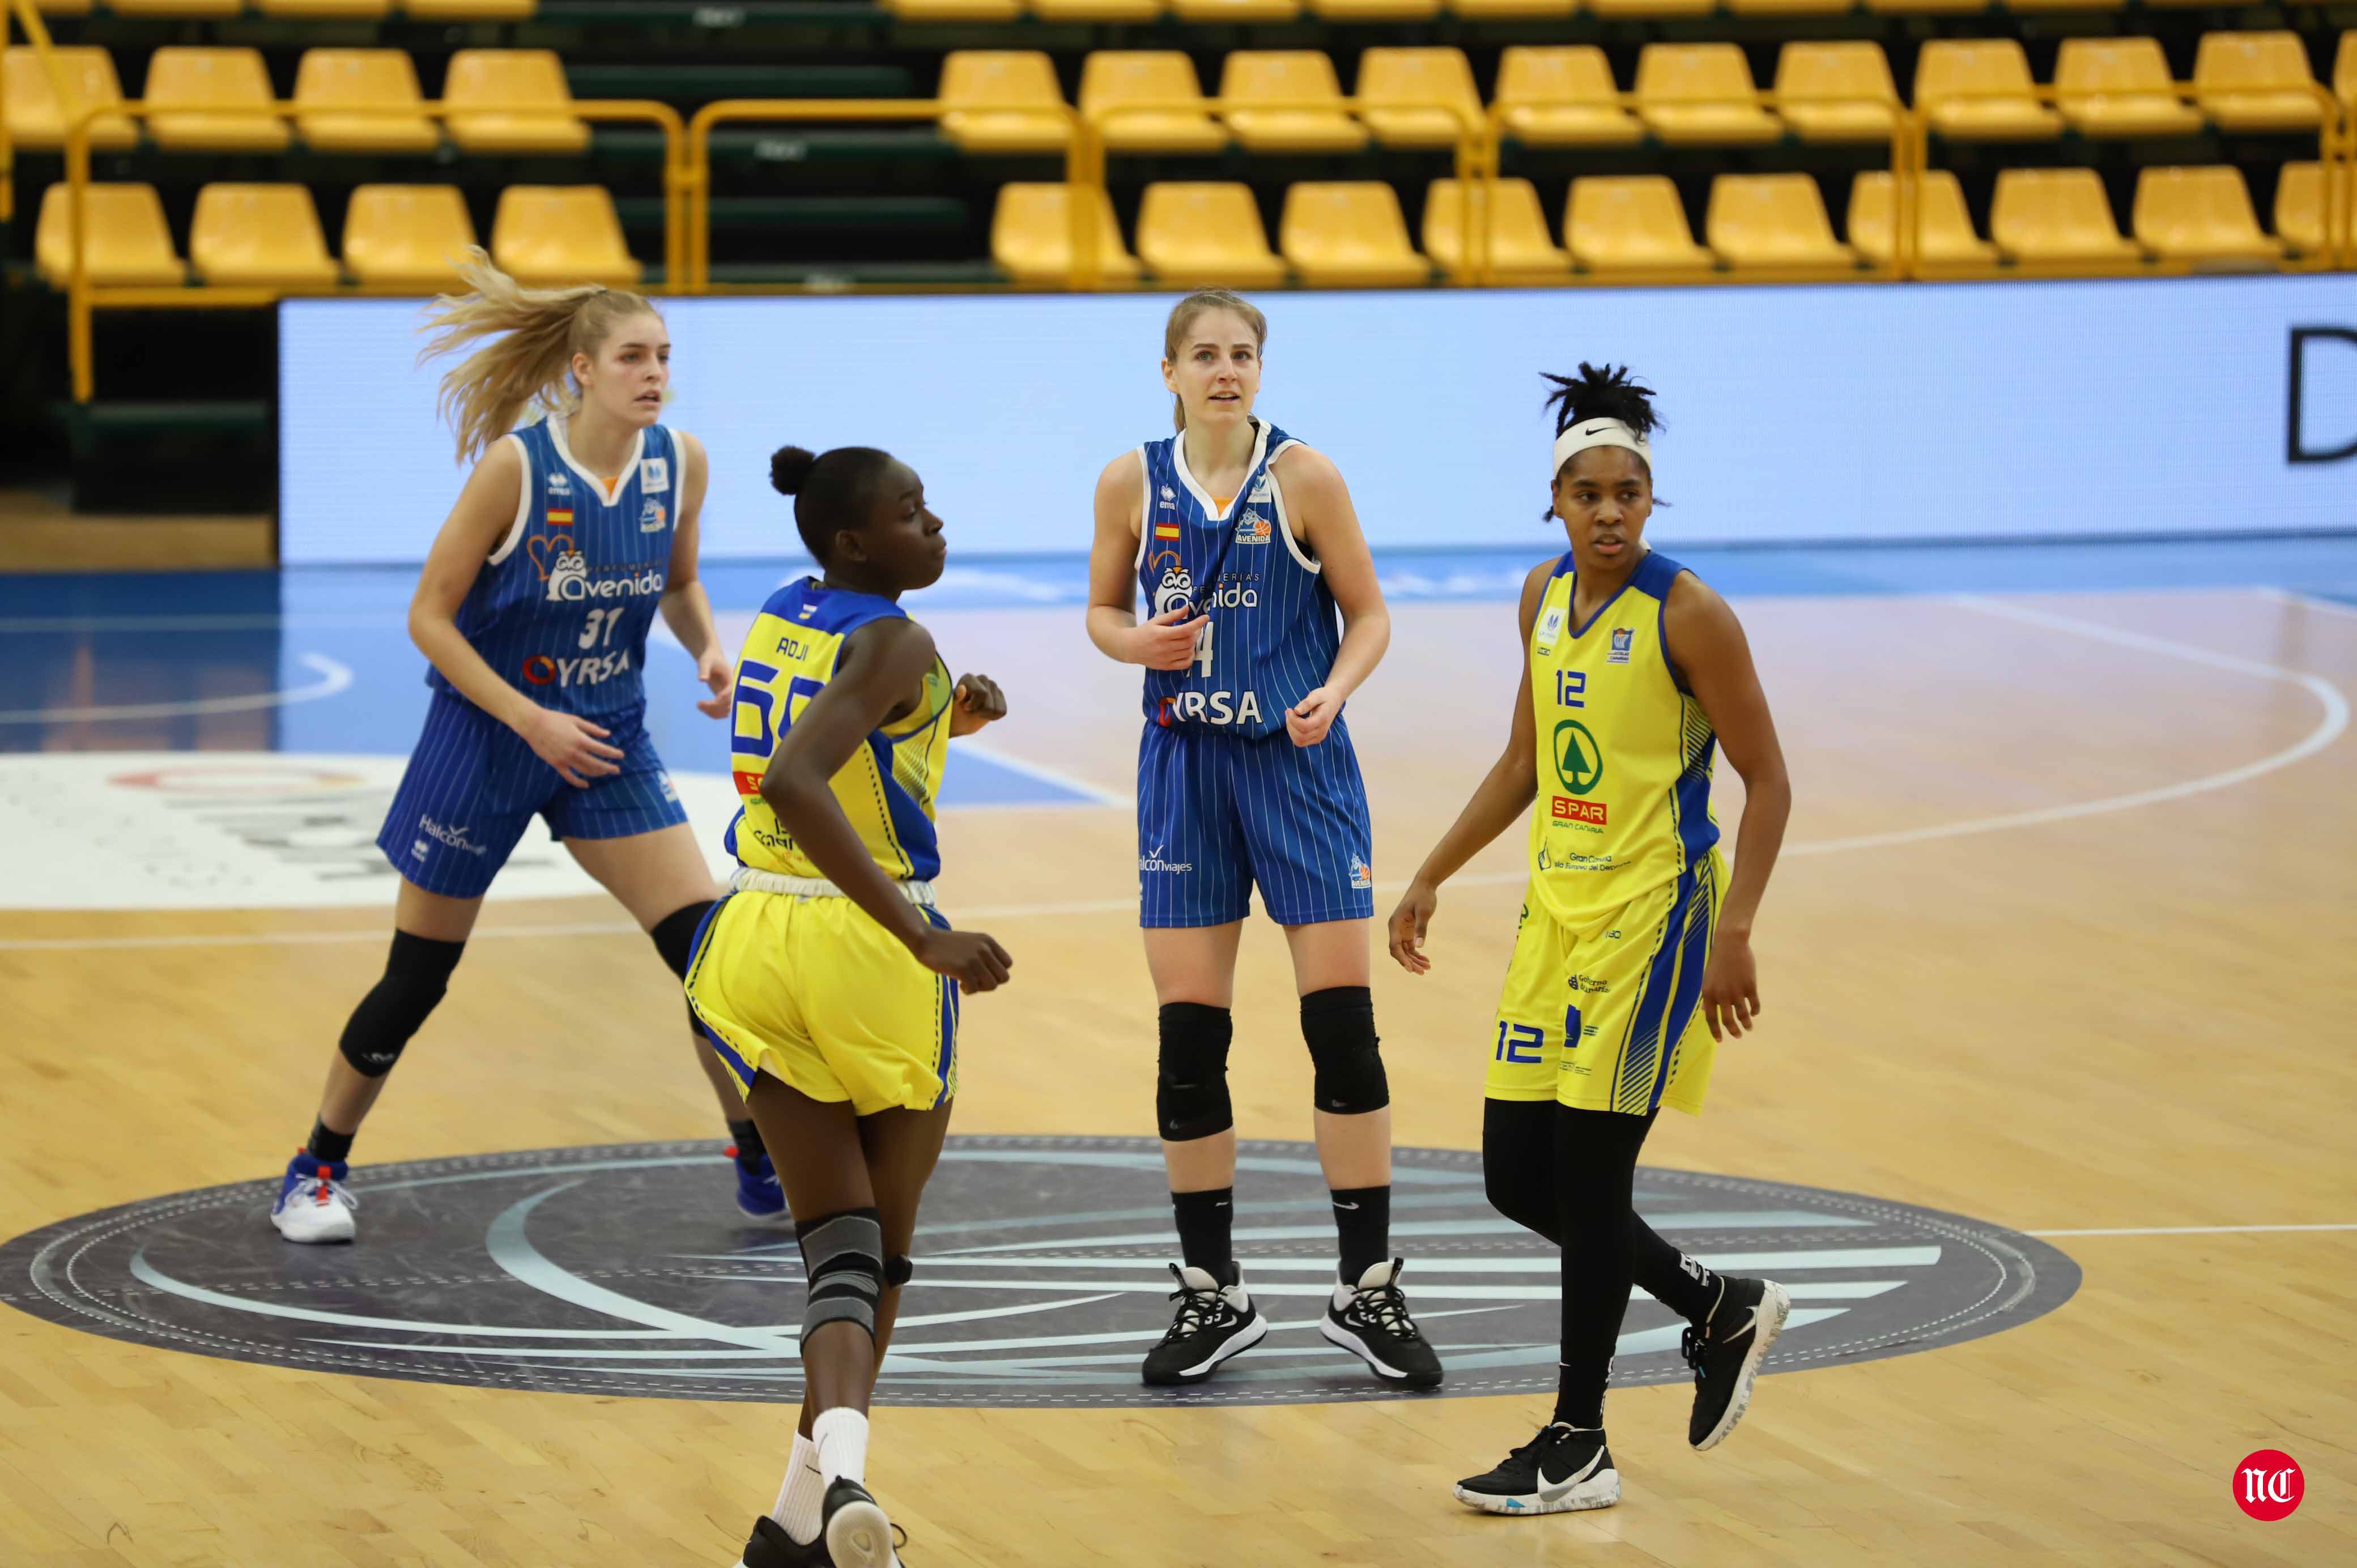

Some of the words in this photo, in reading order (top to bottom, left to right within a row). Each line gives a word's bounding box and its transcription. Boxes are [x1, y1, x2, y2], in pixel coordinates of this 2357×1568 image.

[1237, 534, 1270, 543] AVENIDA
[561, 569, 662, 600] avenida
[578, 607, 625, 649] 31
[776, 637, 809, 661] ADJI
[1556, 670, 1586, 708] 12
[1554, 800, 1604, 820] SPAR
[1569, 853, 1588, 862] Gran
[1496, 1020, 1543, 1063] 12
